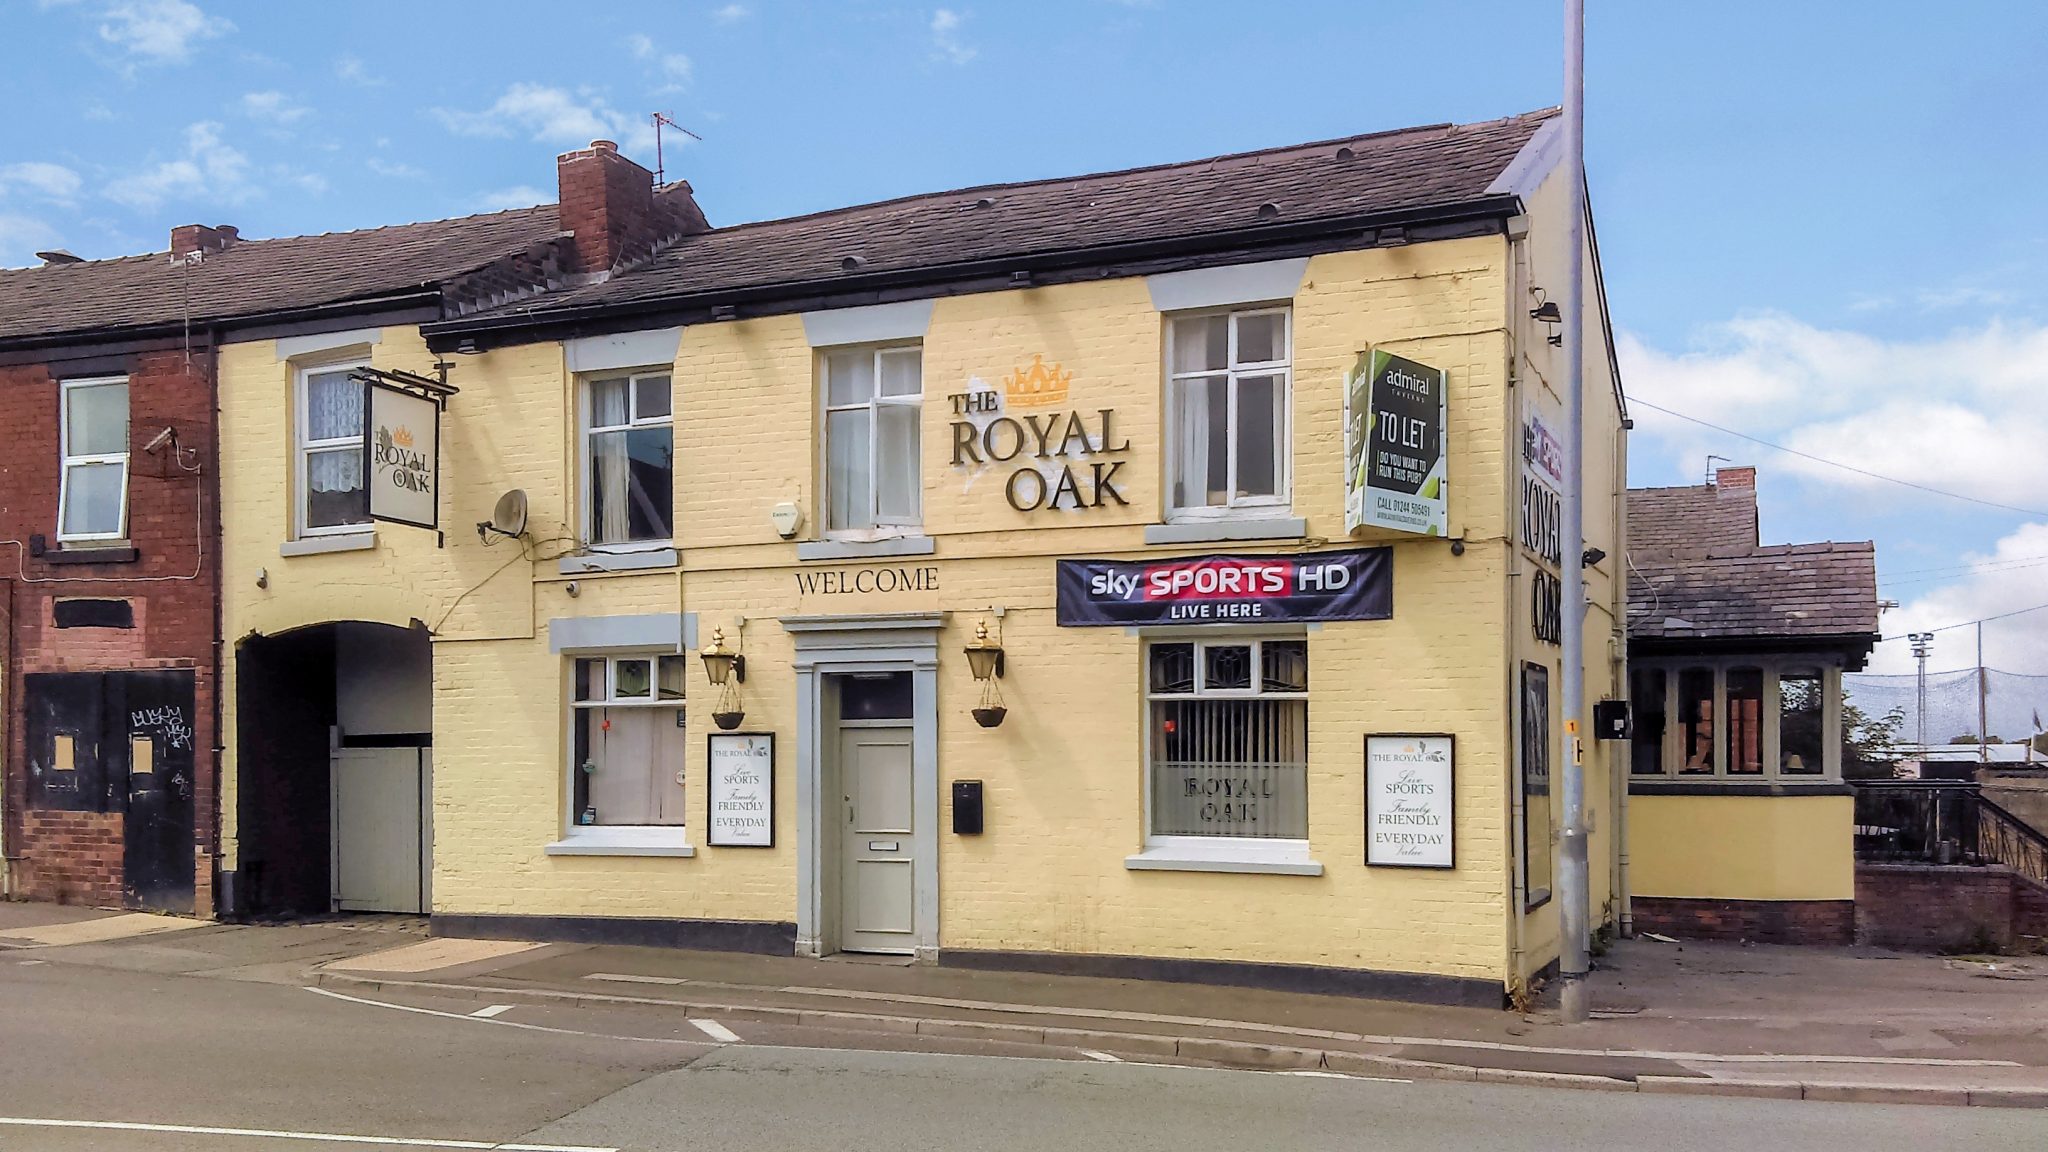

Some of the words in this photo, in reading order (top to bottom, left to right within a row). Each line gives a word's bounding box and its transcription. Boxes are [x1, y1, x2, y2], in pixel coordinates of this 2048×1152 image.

[1386, 368, 1429, 395] admiral
[947, 390, 998, 415] THE
[949, 408, 1130, 465] ROYAL
[1379, 410, 1398, 443] TO
[1402, 416, 1427, 450] LET
[375, 443, 431, 472] ROYAL
[1379, 451, 1389, 465] DO
[1390, 453, 1402, 467] YOU
[1402, 456, 1418, 470] WANT
[1419, 460, 1427, 473] TO
[393, 468, 431, 493] OAK
[1379, 465, 1392, 479] RUN
[1393, 467, 1406, 482] THIS
[1407, 470, 1422, 485] PUB?
[1005, 461, 1130, 512] OAK
[1377, 496, 1392, 511] CALL
[794, 567, 940, 595] WELCOME
[1091, 568, 1140, 599] sky
[1149, 565, 1284, 596] SPORTS
[1298, 564, 1350, 593] HD
[1170, 604, 1210, 619] LIVE
[1216, 602, 1262, 618] HERE
[730, 749, 752, 757] ROYAL
[1372, 754, 1391, 762] THE
[1393, 753, 1422, 762] ROYAL
[724, 775, 760, 785] SPORTS
[1184, 777, 1273, 799] ROYAL
[1385, 783, 1434, 795] SPORTS
[718, 801, 765, 811] FRIENDLY
[1200, 802, 1257, 823] OAK
[1387, 799, 1431, 816] Family
[716, 817, 767, 827] EVERYDAY
[1378, 813, 1441, 826] FRIENDLY
[1375, 832, 1444, 845] EVERYDAY
